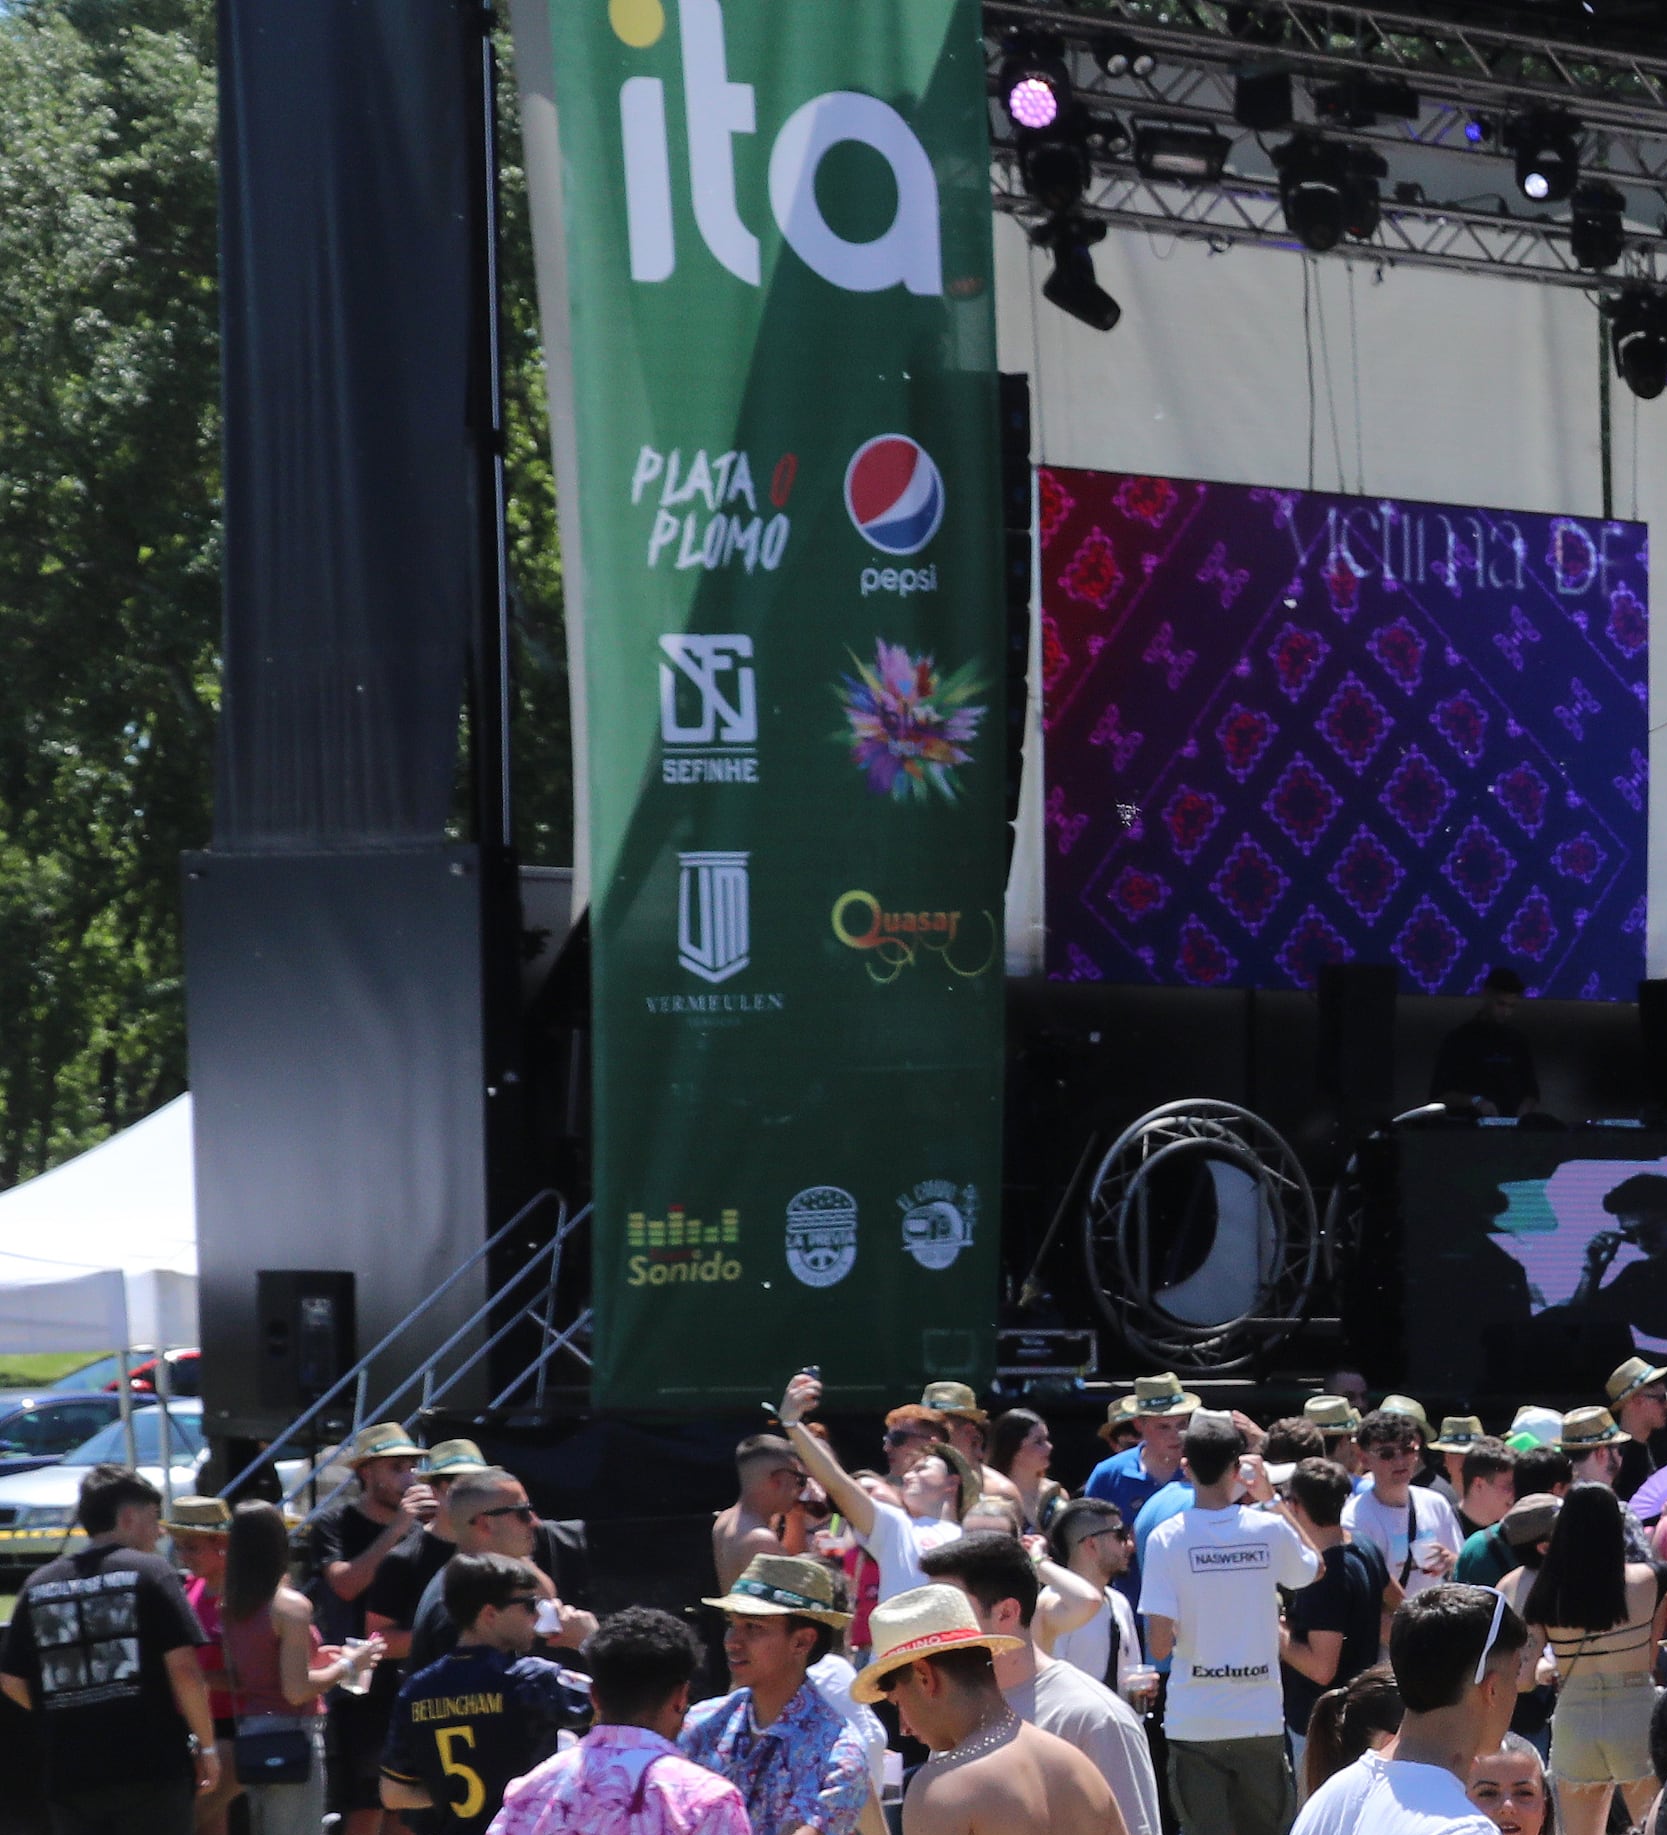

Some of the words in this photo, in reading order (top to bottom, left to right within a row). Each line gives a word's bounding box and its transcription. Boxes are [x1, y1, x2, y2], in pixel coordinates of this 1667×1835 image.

[618, 0, 944, 297] ita
[631, 444, 756, 511] PLATA
[647, 510, 790, 575] PLOMO
[860, 563, 938, 595] pepsi
[662, 758, 759, 784] SEFINHE
[831, 890, 975, 968] Quasar
[645, 992, 785, 1014] VERMEULEN
[626, 1251, 743, 1287] Sonido
[411, 1692, 503, 1723] BELLINGHAM
[434, 1725, 486, 1818] 5
